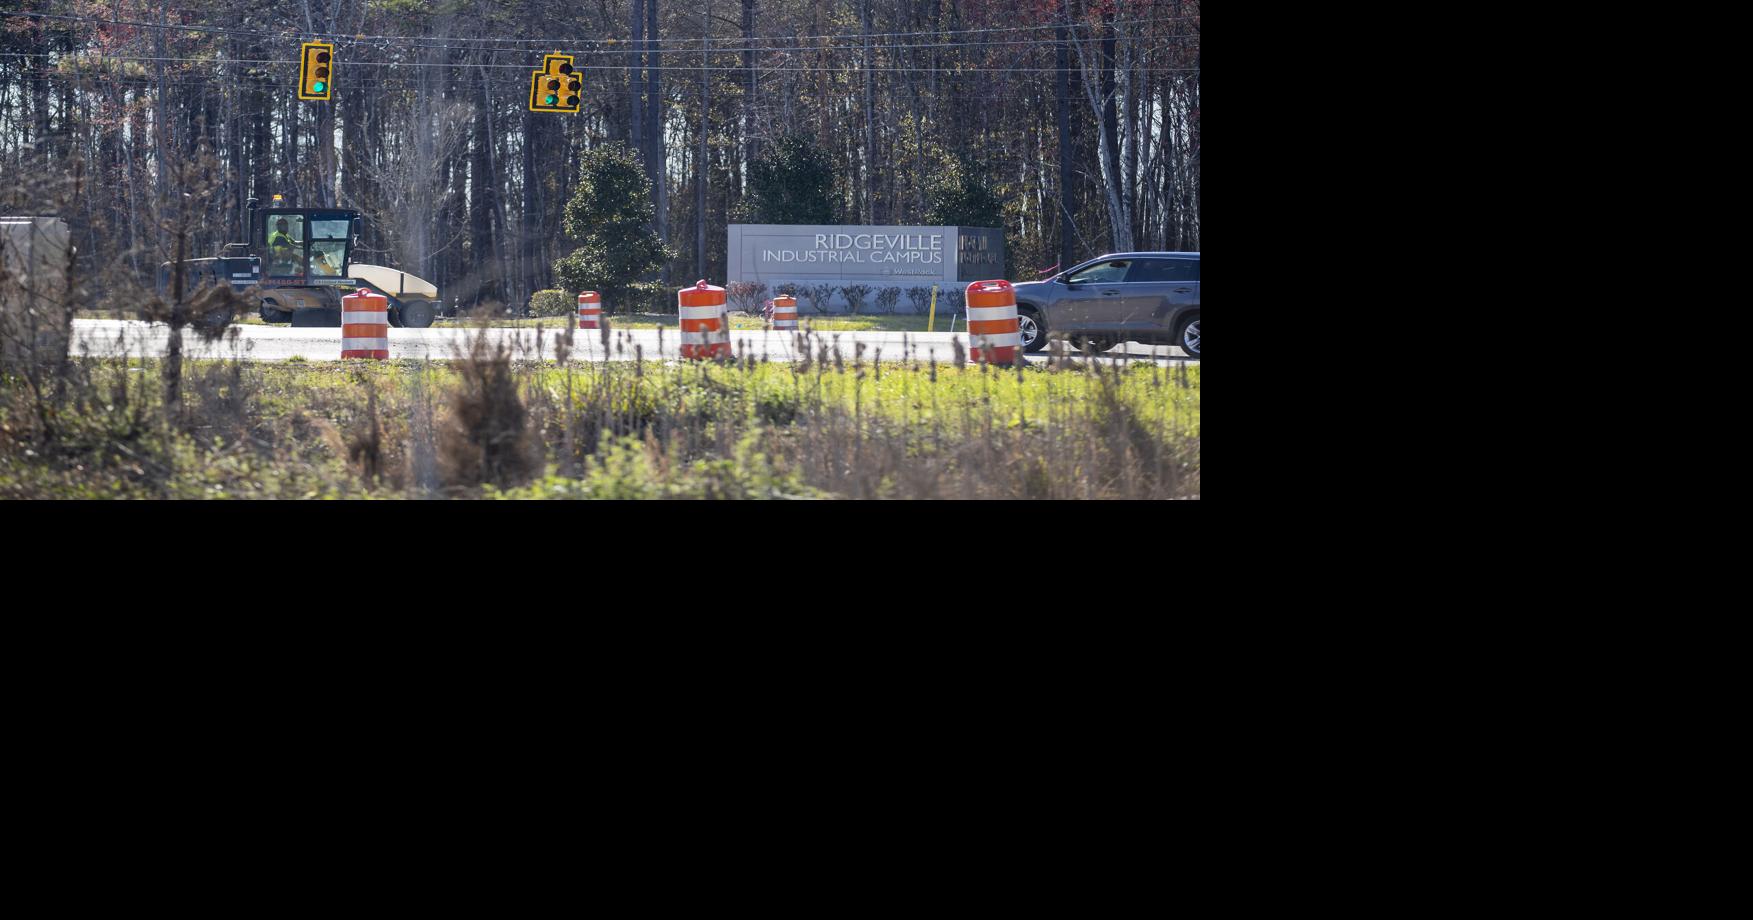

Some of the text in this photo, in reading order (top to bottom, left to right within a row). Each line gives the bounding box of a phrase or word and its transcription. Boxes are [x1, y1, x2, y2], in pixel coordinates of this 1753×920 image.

[815, 233, 942, 250] RIDGEVILLE
[762, 250, 942, 264] INDUSTRIAL CAMPUS
